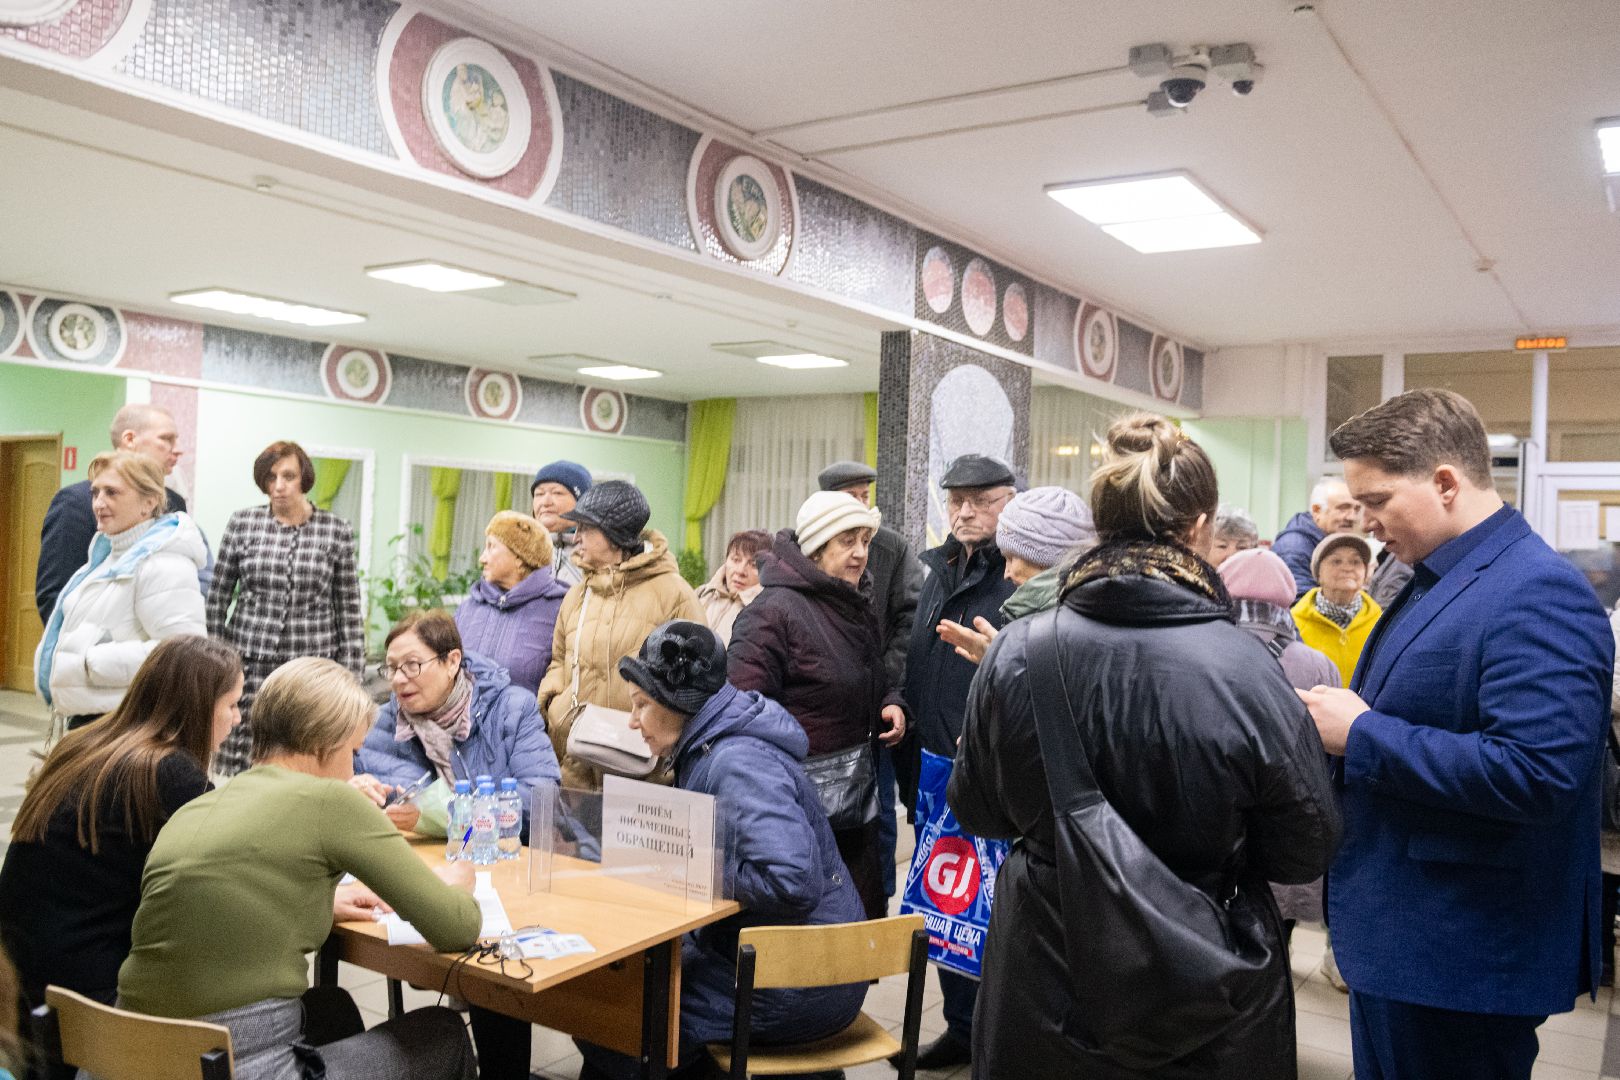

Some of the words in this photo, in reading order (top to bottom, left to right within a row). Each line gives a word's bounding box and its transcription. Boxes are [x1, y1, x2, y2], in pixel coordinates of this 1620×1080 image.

[1516, 338, 1566, 348] ВЫХОД
[637, 803, 673, 820] ПРИЁМ
[927, 852, 976, 898] GJ
[953, 923, 981, 946] ЦЕНА
